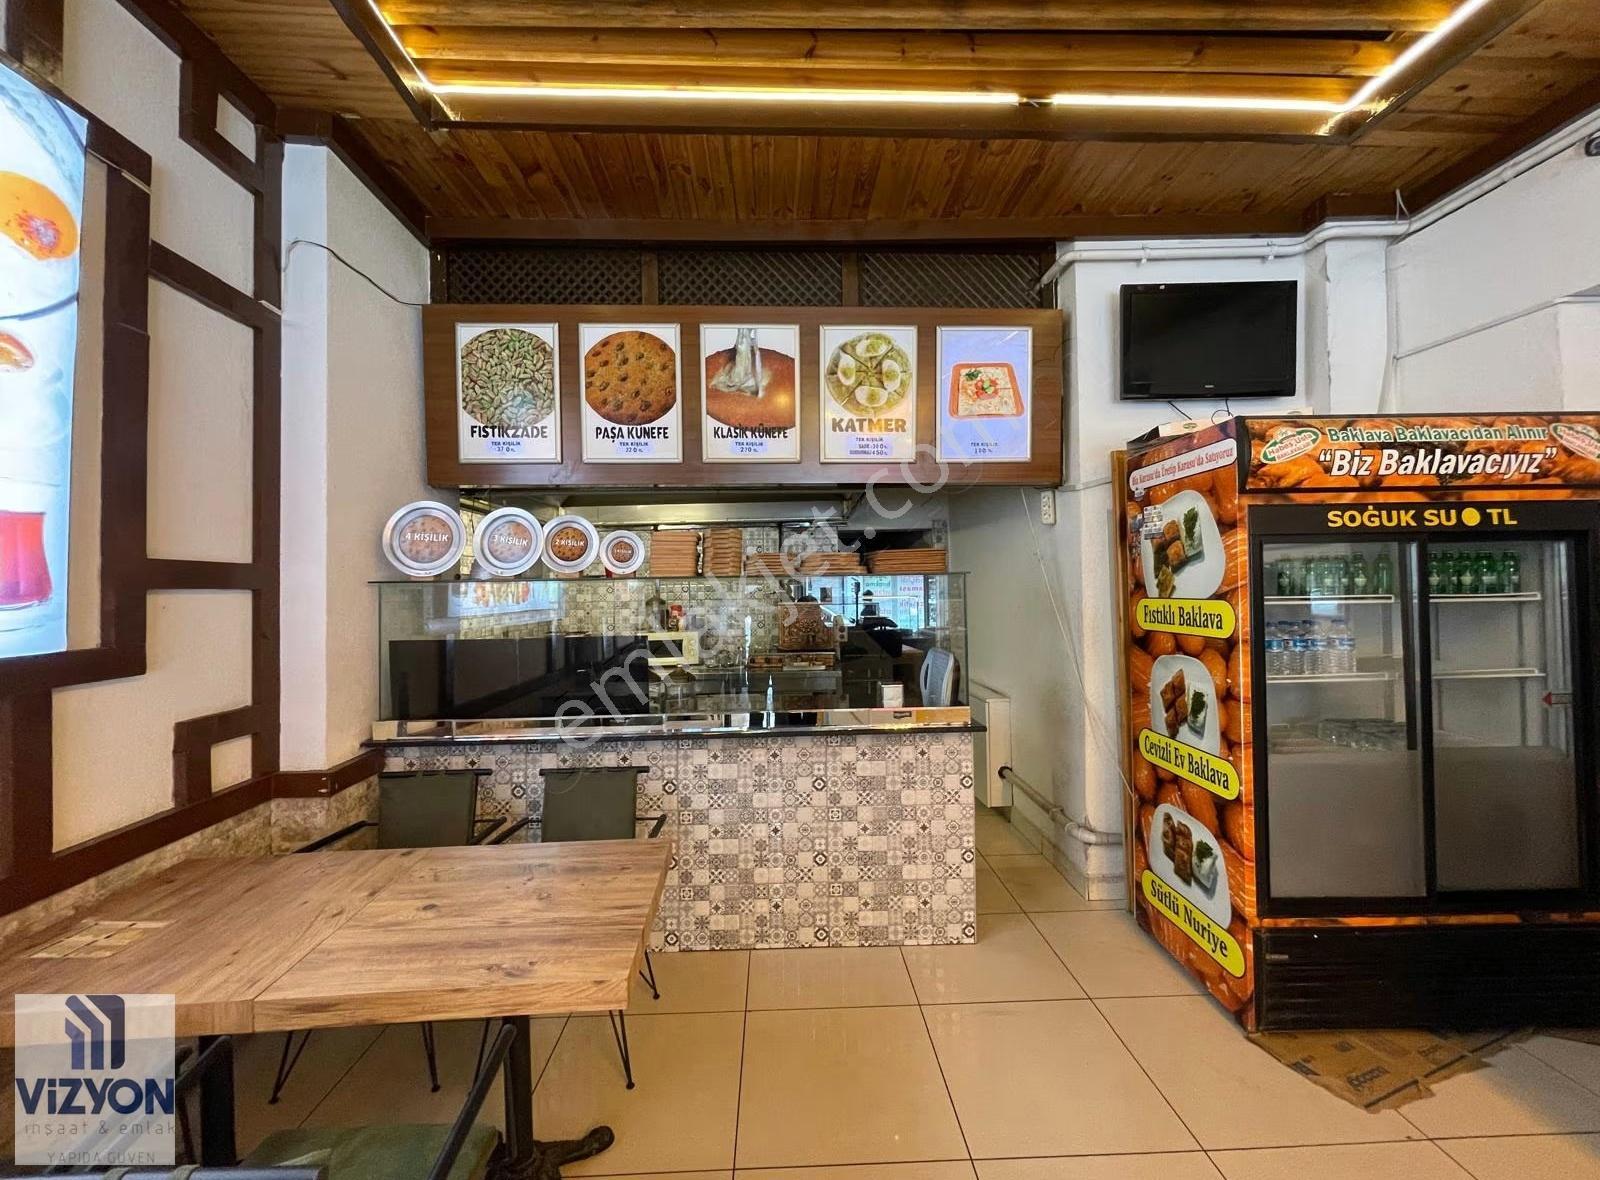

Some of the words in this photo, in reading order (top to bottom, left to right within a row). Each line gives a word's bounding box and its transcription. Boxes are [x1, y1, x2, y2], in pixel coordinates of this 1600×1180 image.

[470, 425, 548, 438] FISTIKZADE
[713, 423, 748, 439] KLASİK
[832, 418, 906, 433] KATMER
[1327, 427, 1393, 441] Baklava
[1395, 426, 1503, 441] Baklavacıdan
[1507, 426, 1548, 440] Alınır
[595, 426, 625, 443] PAŞA
[1327, 505, 1417, 528] SOĞUK
[1423, 509, 1457, 527] SU
[1486, 508, 1517, 526] TL
[405, 532, 412, 540] 4
[414, 531, 449, 542] KİŞİLİK
[493, 534, 499, 542] 3
[500, 536, 529, 546] KİŞİLİK
[1143, 604, 1175, 626] Fıstıklı
[1178, 605, 1223, 630] Baklava
[1144, 735, 1172, 764] Cevizli
[1173, 746, 1186, 770] Ev
[1187, 752, 1230, 791] Baklava
[1150, 879, 1180, 918] Sütlü
[1183, 903, 1228, 958] Nuriye
